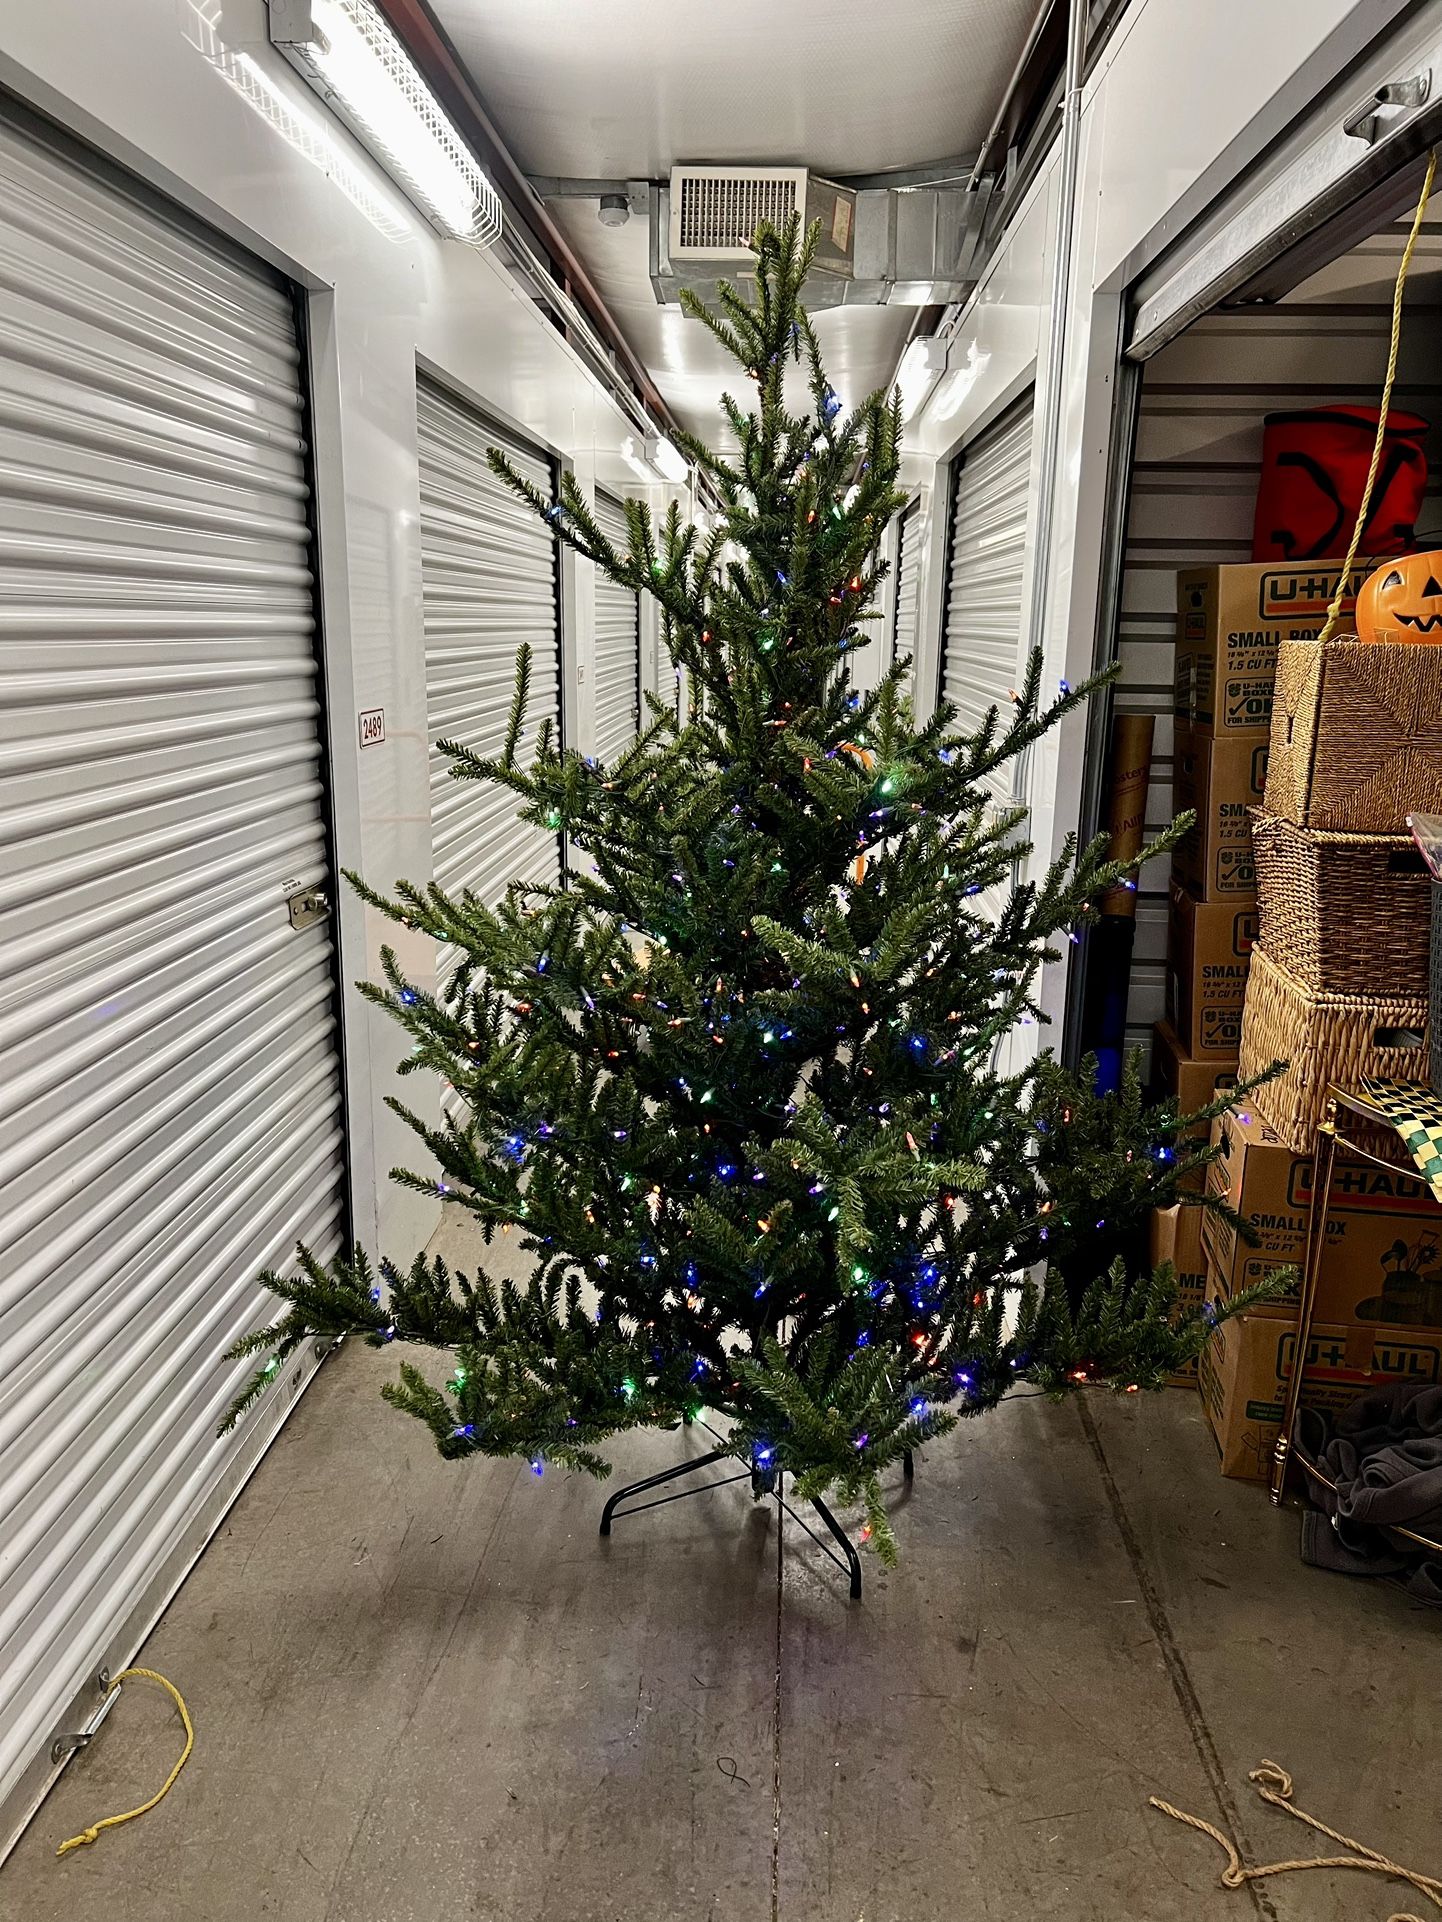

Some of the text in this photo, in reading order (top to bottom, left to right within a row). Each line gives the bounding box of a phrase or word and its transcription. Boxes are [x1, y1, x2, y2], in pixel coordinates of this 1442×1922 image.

[1228, 660, 1244, 671] 1.5
[1247, 659, 1262, 670] CU
[363, 715, 382, 740] 2489
[1219, 829, 1248, 838] 1.5 CU
[1202, 990, 1216, 998] 1.5
[1217, 990, 1230, 998] CU
[1251, 1213, 1307, 1232] SMALL
[1265, 1241, 1280, 1251] CU
[1281, 1243, 1296, 1252] FT
